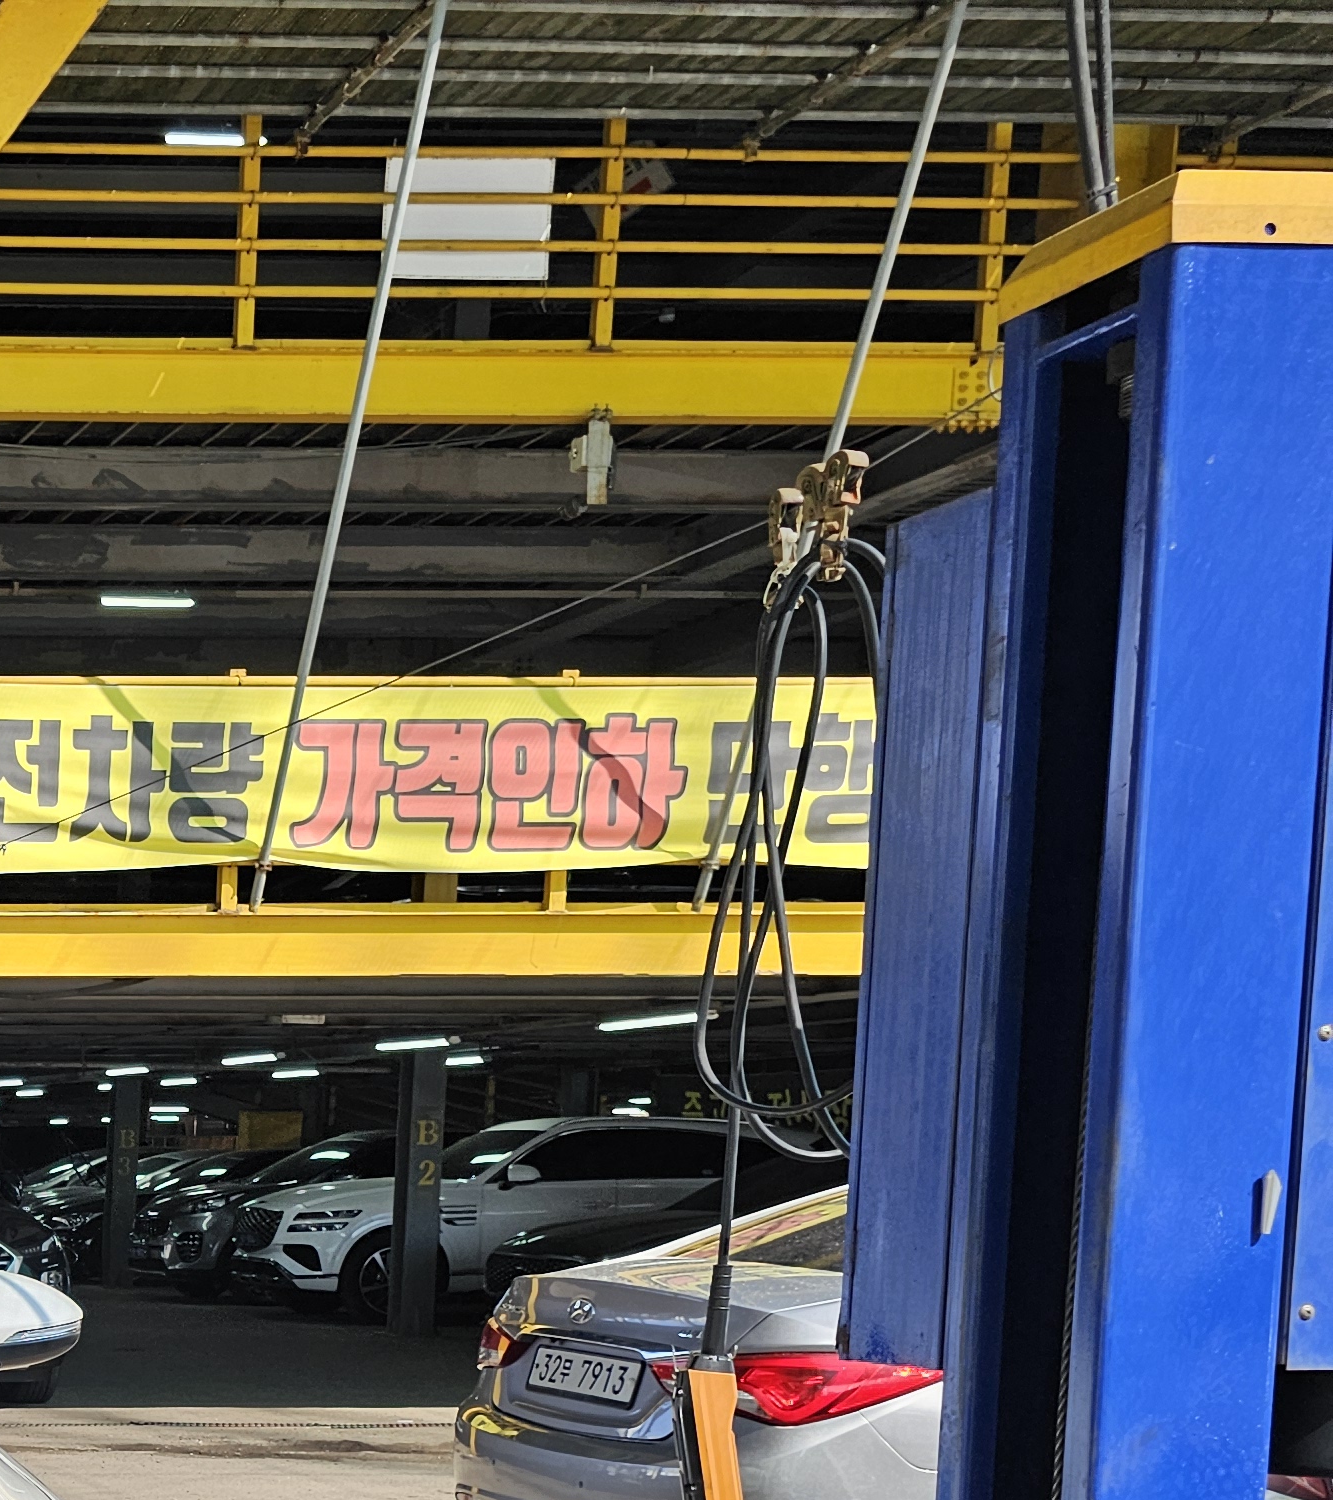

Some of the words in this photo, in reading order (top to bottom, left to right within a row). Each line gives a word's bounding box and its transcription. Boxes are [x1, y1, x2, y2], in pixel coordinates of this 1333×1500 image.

[289, 711, 688, 854] 가격인하
[417, 1119, 438, 1146] B
[118, 1156, 131, 1176] 3
[418, 1160, 436, 1186] 2
[538, 1353, 574, 1384] 32무
[577, 1359, 630, 1395] 7913
